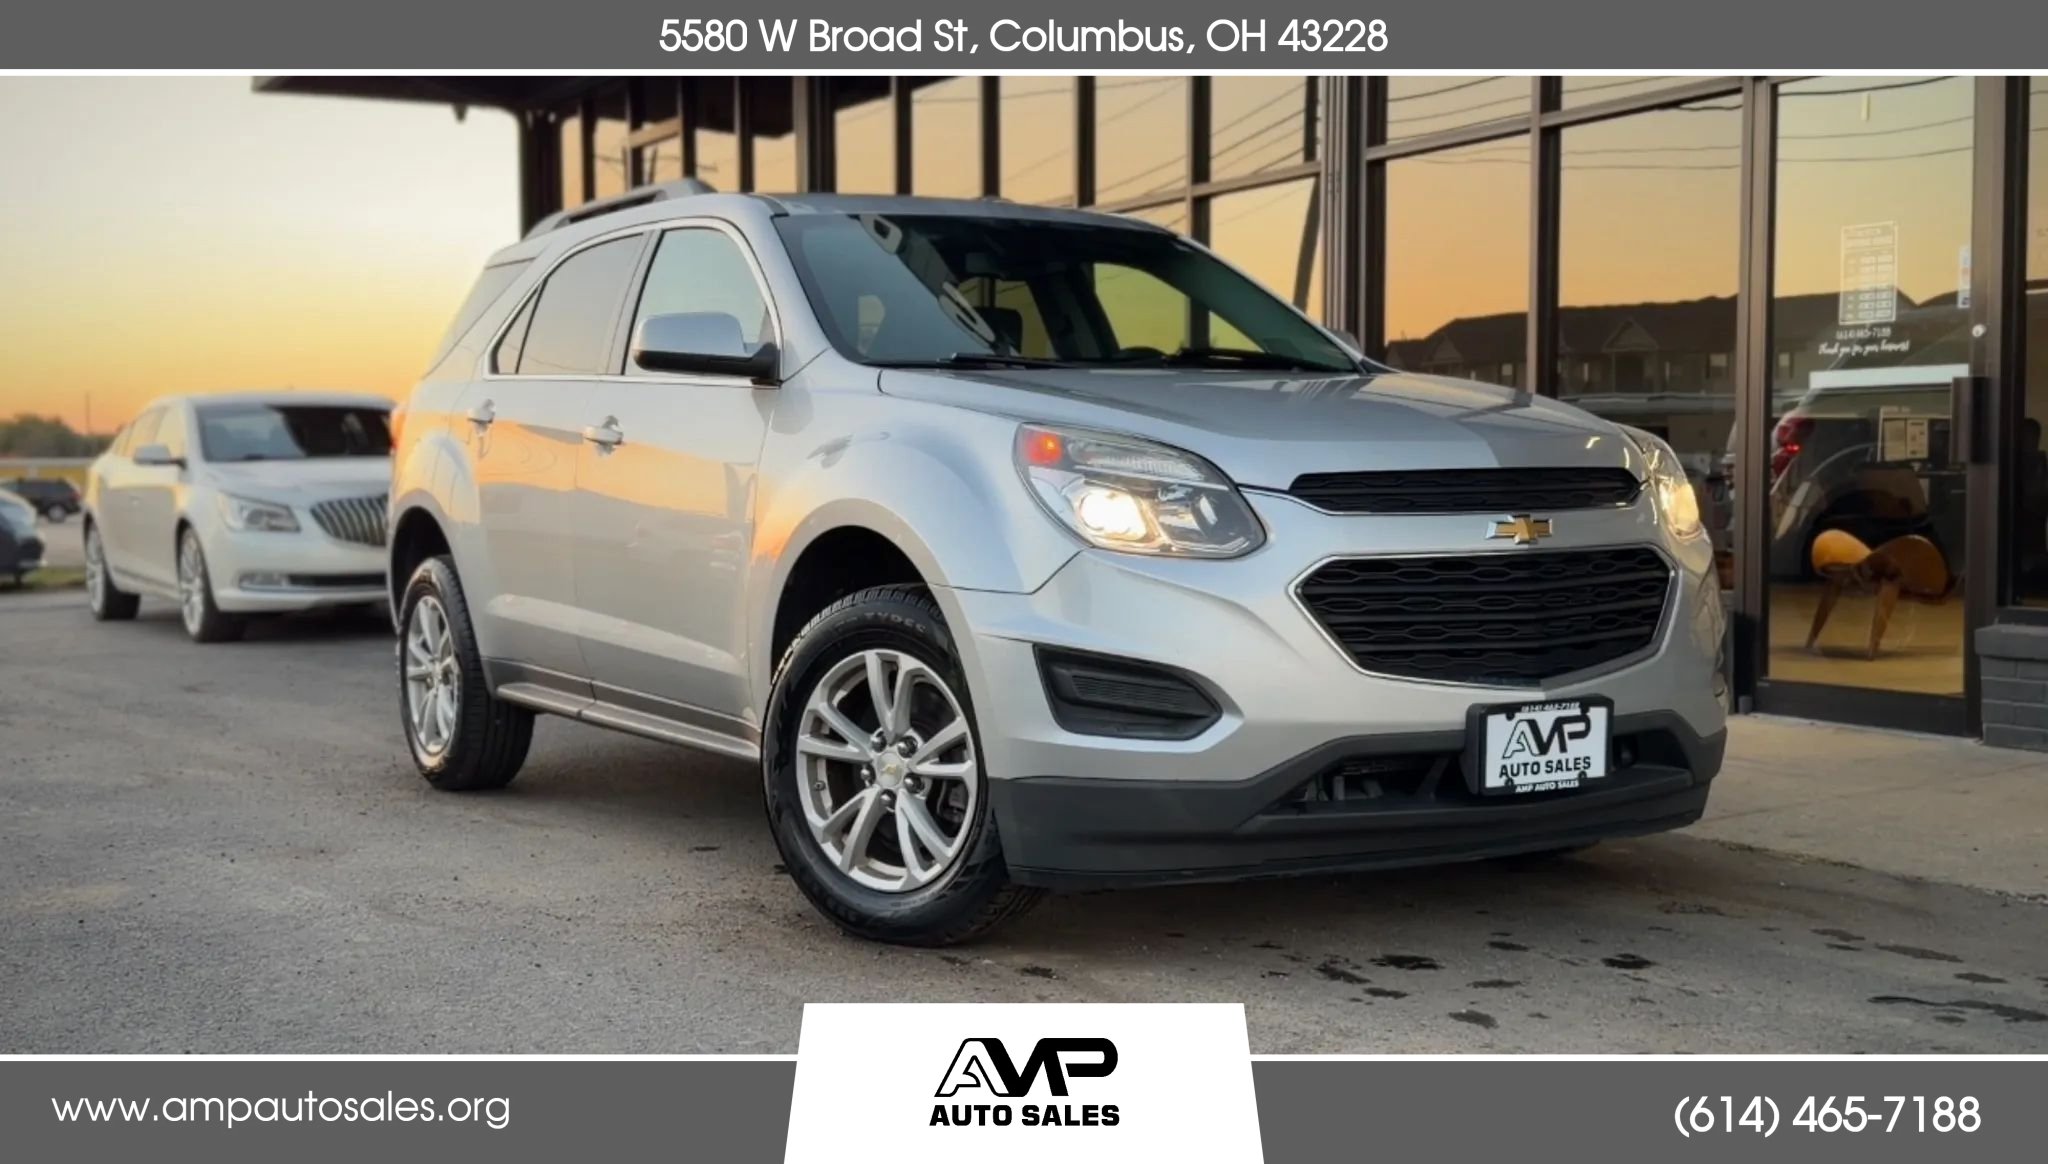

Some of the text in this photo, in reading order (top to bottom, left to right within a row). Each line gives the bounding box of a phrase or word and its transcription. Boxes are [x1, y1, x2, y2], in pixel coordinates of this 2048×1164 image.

[1502, 714, 1591, 759] AMP
[1499, 756, 1591, 778] AUTO SALES
[1515, 779, 1579, 793] AMP AUTO SALES
